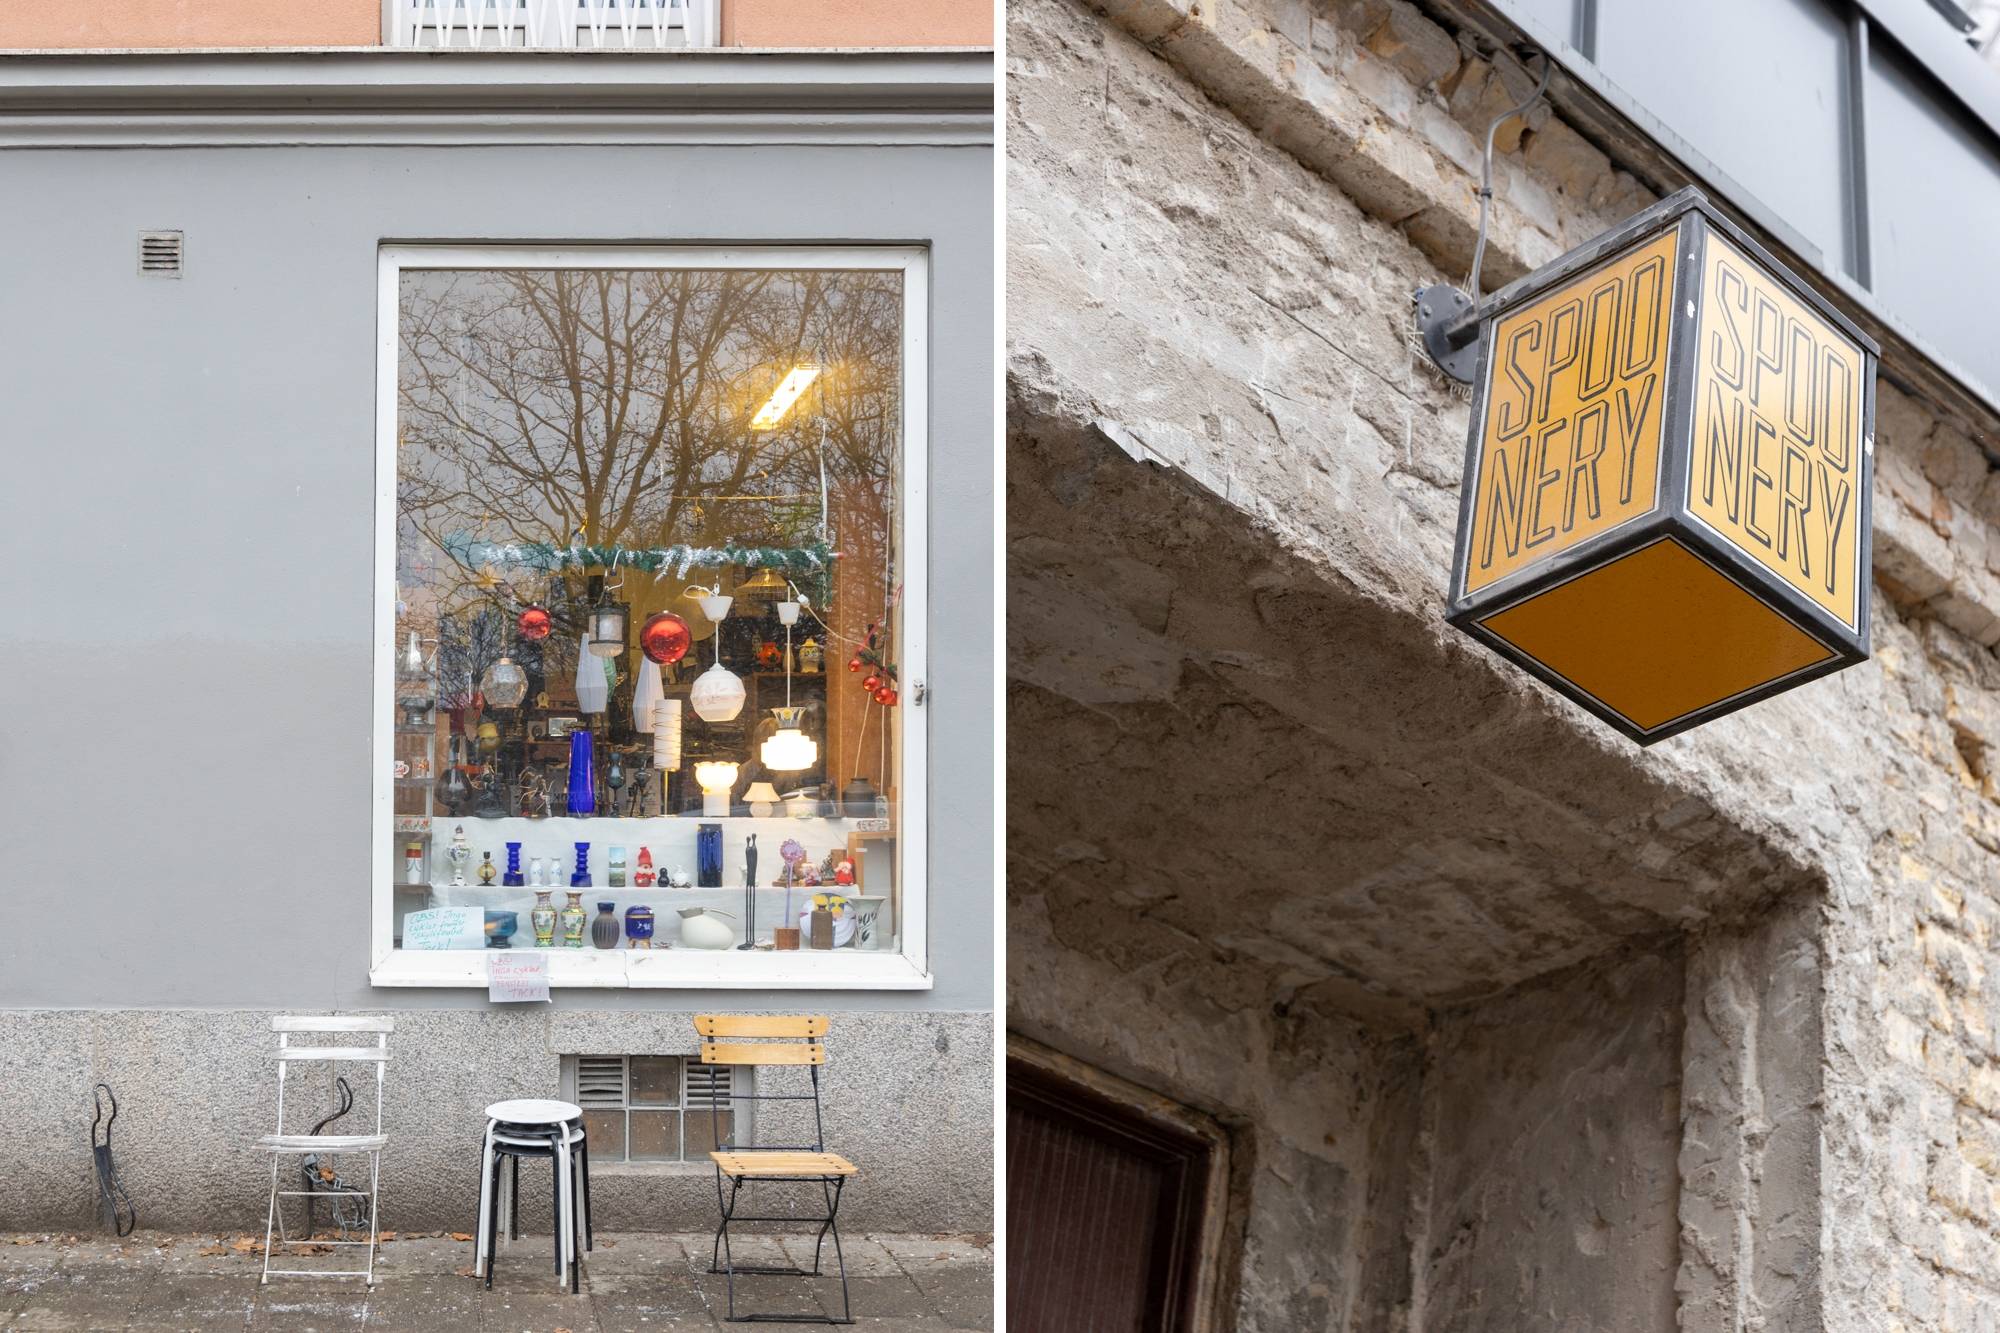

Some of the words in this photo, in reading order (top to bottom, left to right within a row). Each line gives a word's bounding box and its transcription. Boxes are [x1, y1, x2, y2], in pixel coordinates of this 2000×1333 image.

[1496, 254, 1666, 442] SPOO
[1710, 258, 1852, 475] SPOO
[1480, 373, 1657, 570] NERY
[1702, 377, 1850, 596] NERY
